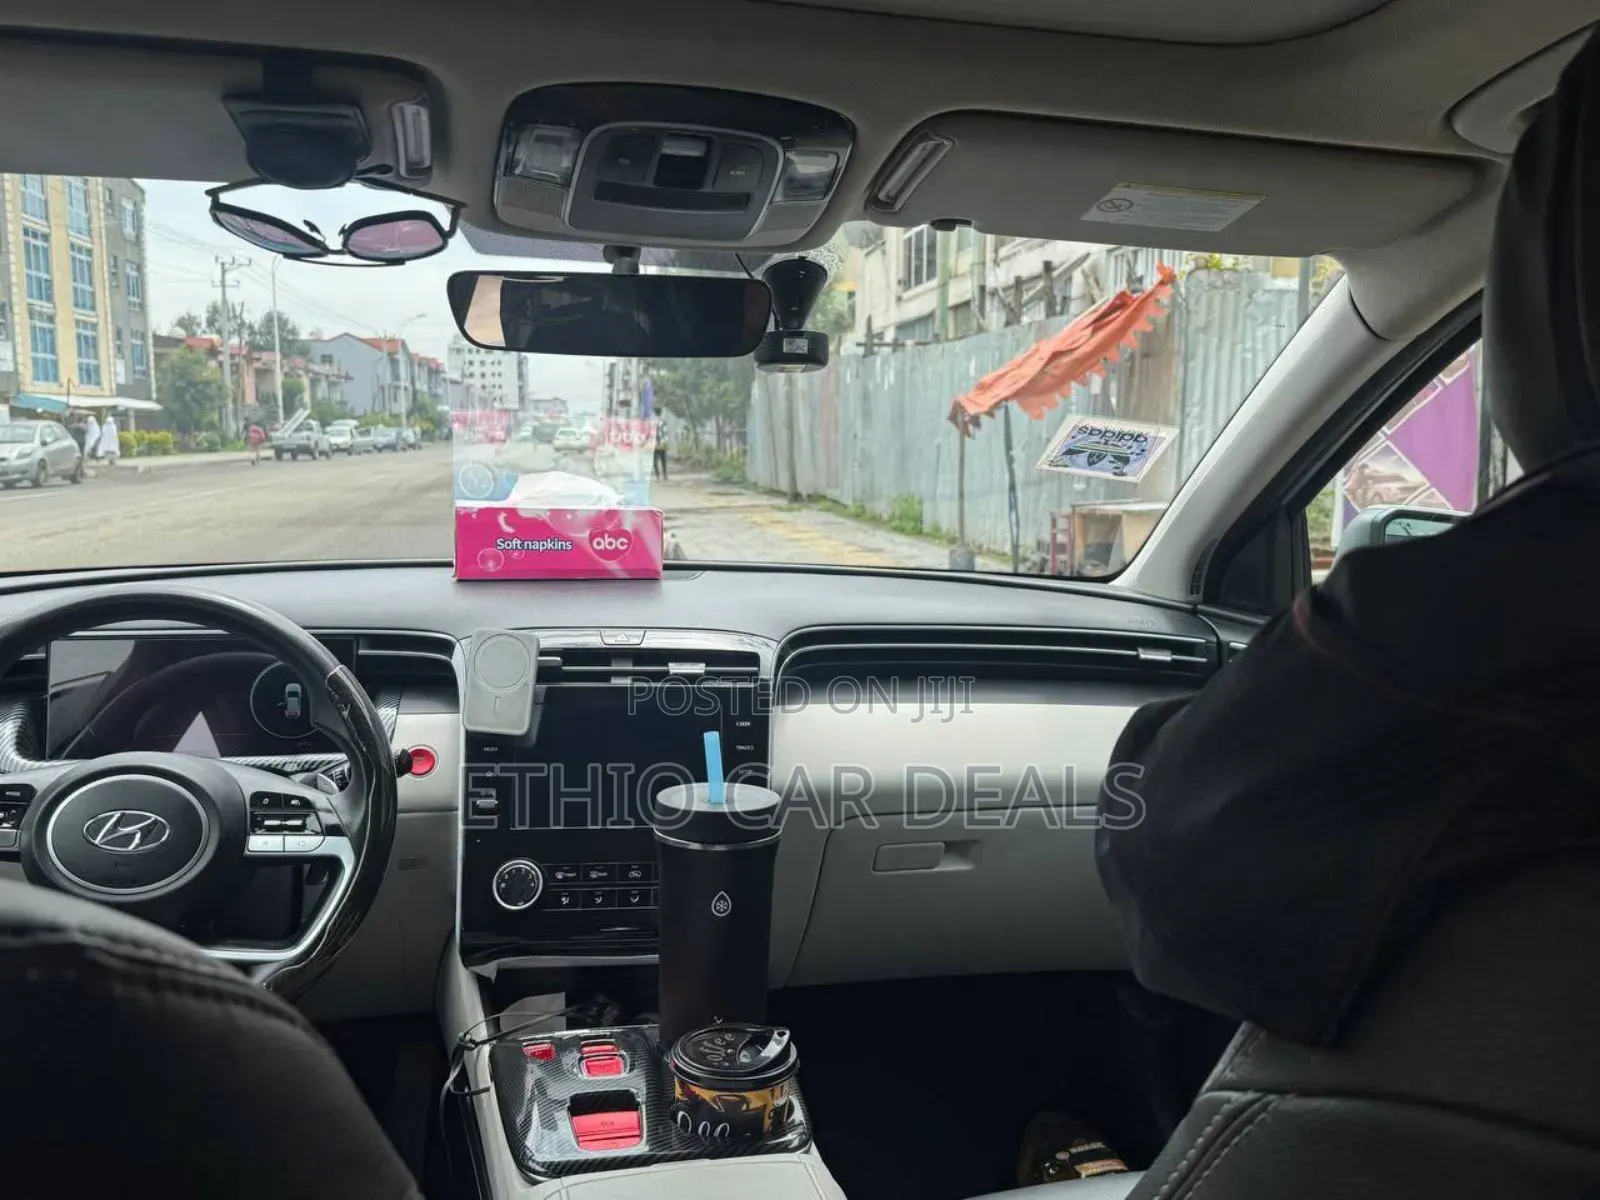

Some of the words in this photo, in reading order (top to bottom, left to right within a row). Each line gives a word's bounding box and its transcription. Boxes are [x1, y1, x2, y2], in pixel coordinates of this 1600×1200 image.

[1077, 424, 1148, 443] adidas
[496, 537, 523, 550] Soft
[523, 538, 572, 553] napkins
[592, 534, 629, 550] abc
